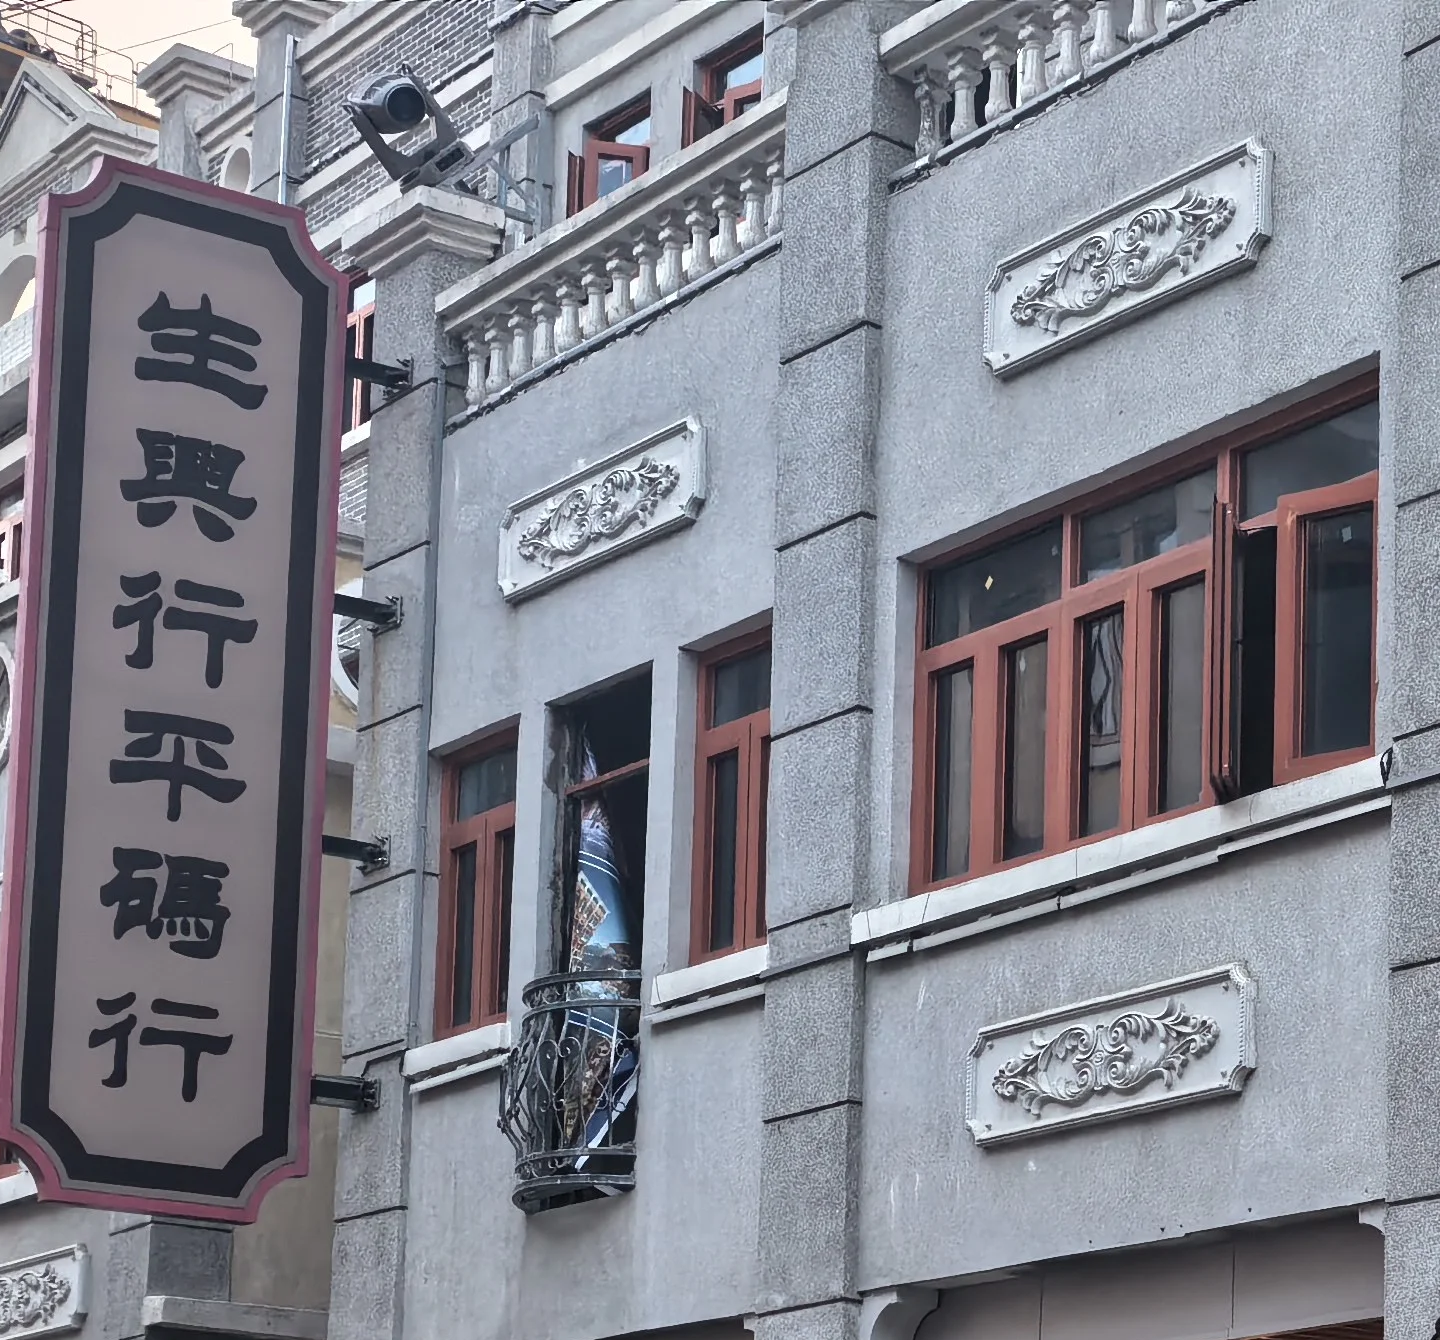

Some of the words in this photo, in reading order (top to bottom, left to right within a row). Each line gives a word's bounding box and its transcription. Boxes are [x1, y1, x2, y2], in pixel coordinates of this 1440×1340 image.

[88, 292, 268, 1102] 生興行平碼行
